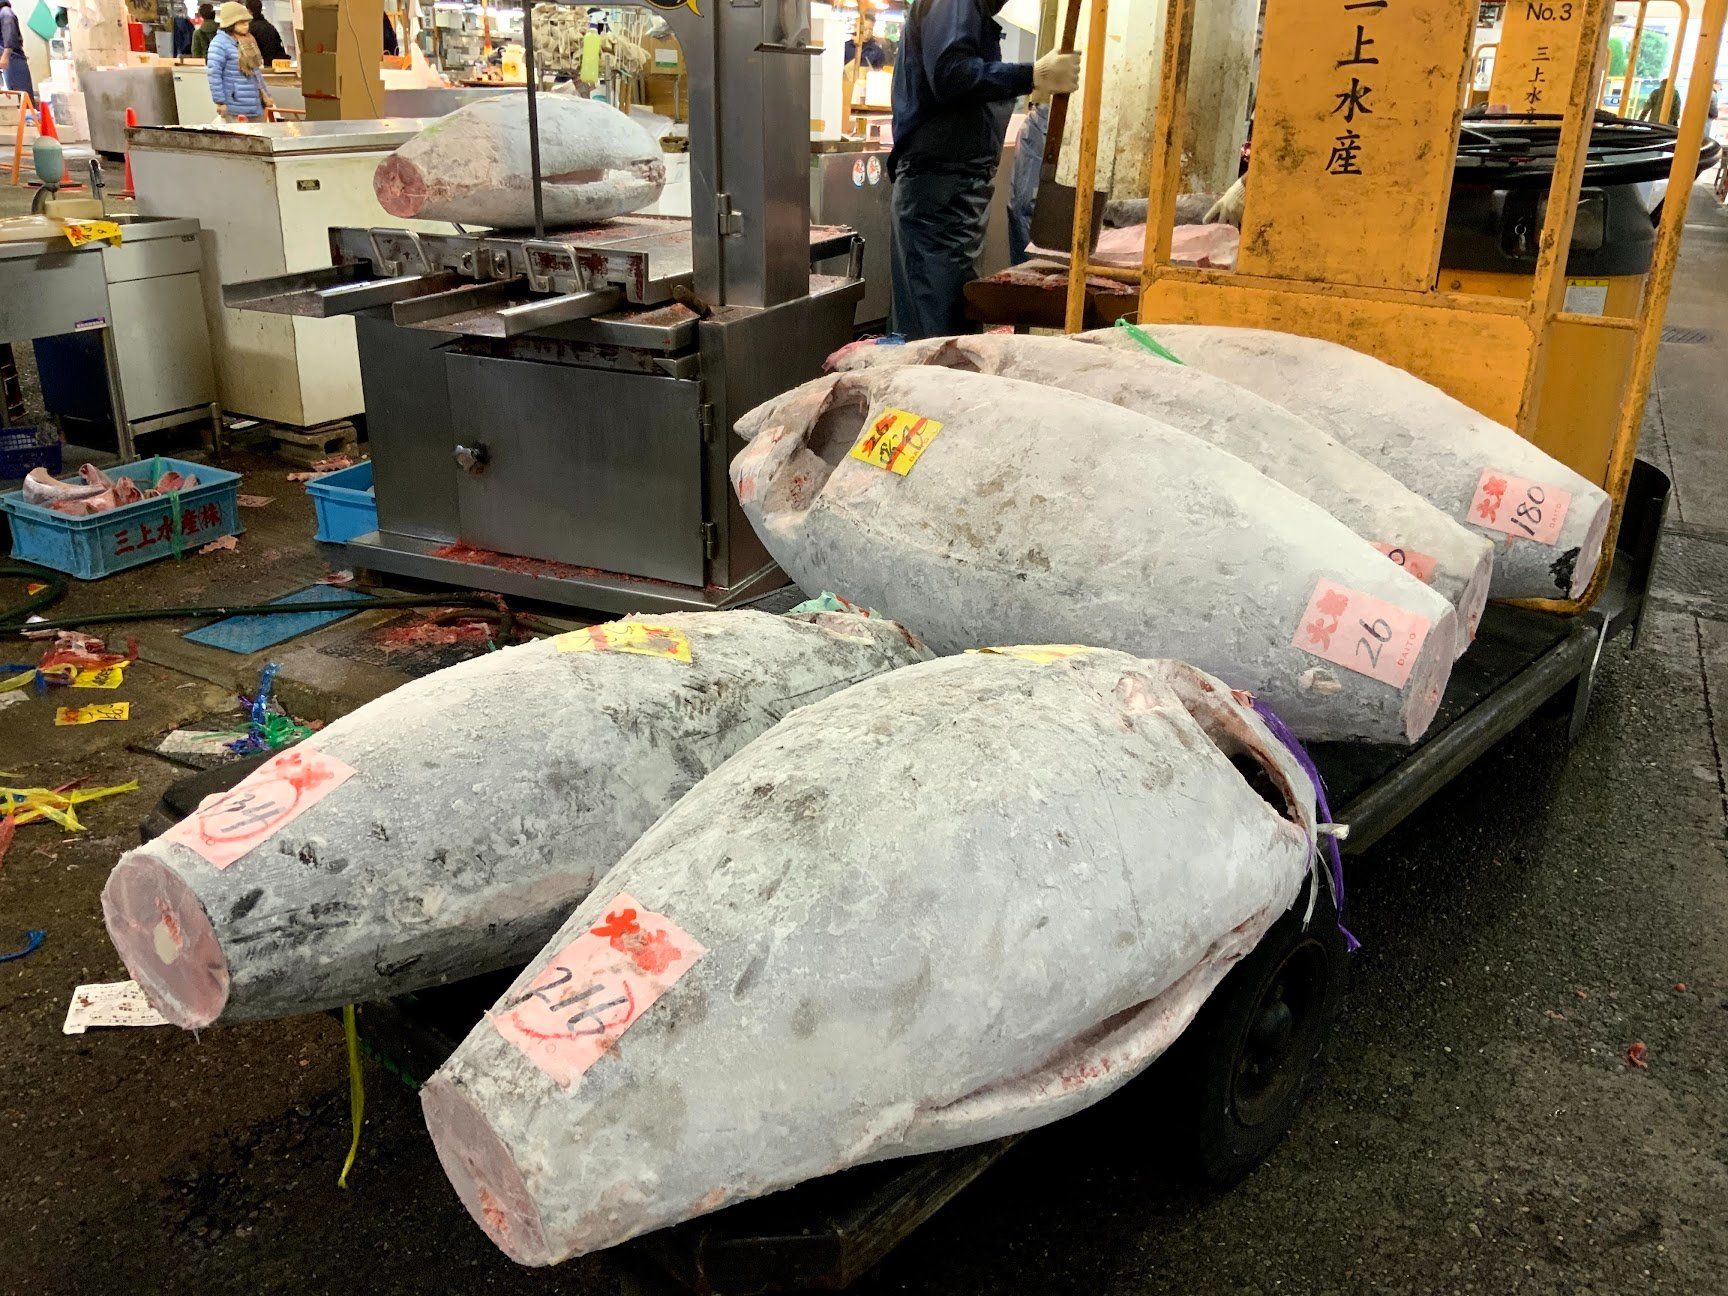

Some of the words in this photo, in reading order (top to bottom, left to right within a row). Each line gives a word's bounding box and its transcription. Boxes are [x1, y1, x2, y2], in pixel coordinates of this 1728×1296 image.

[1526, 2, 1573, 21] No.3
[1510, 486, 1545, 536] 180
[1355, 618, 1393, 669] 26
[1397, 632, 1417, 666] DAITO
